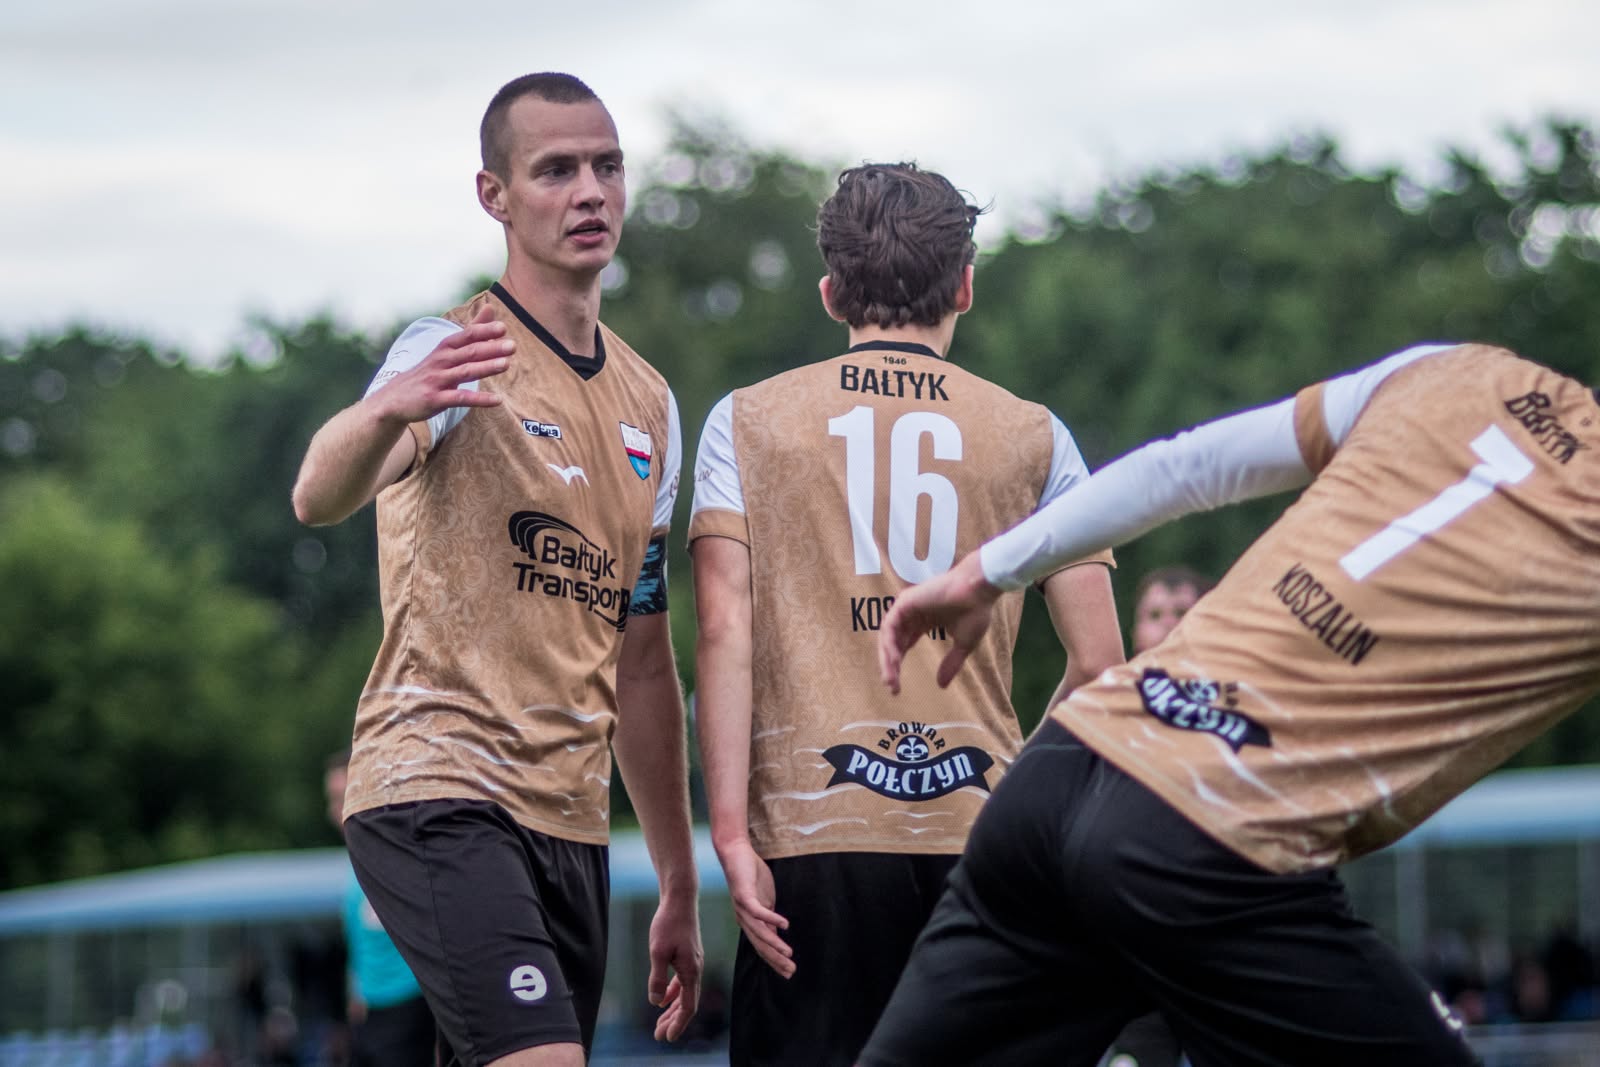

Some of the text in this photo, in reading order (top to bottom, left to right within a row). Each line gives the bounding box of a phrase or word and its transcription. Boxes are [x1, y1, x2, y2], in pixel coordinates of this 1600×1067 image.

[840, 364, 949, 401] BAŁTYK
[882, 355, 907, 365] 1946
[828, 405, 963, 585] 16
[1338, 423, 1535, 582] 7
[541, 535, 616, 581] Bałtyk
[512, 562, 622, 611] Transpor
[1272, 562, 1379, 666] KOSZALIN
[878, 721, 946, 750] BROWAR
